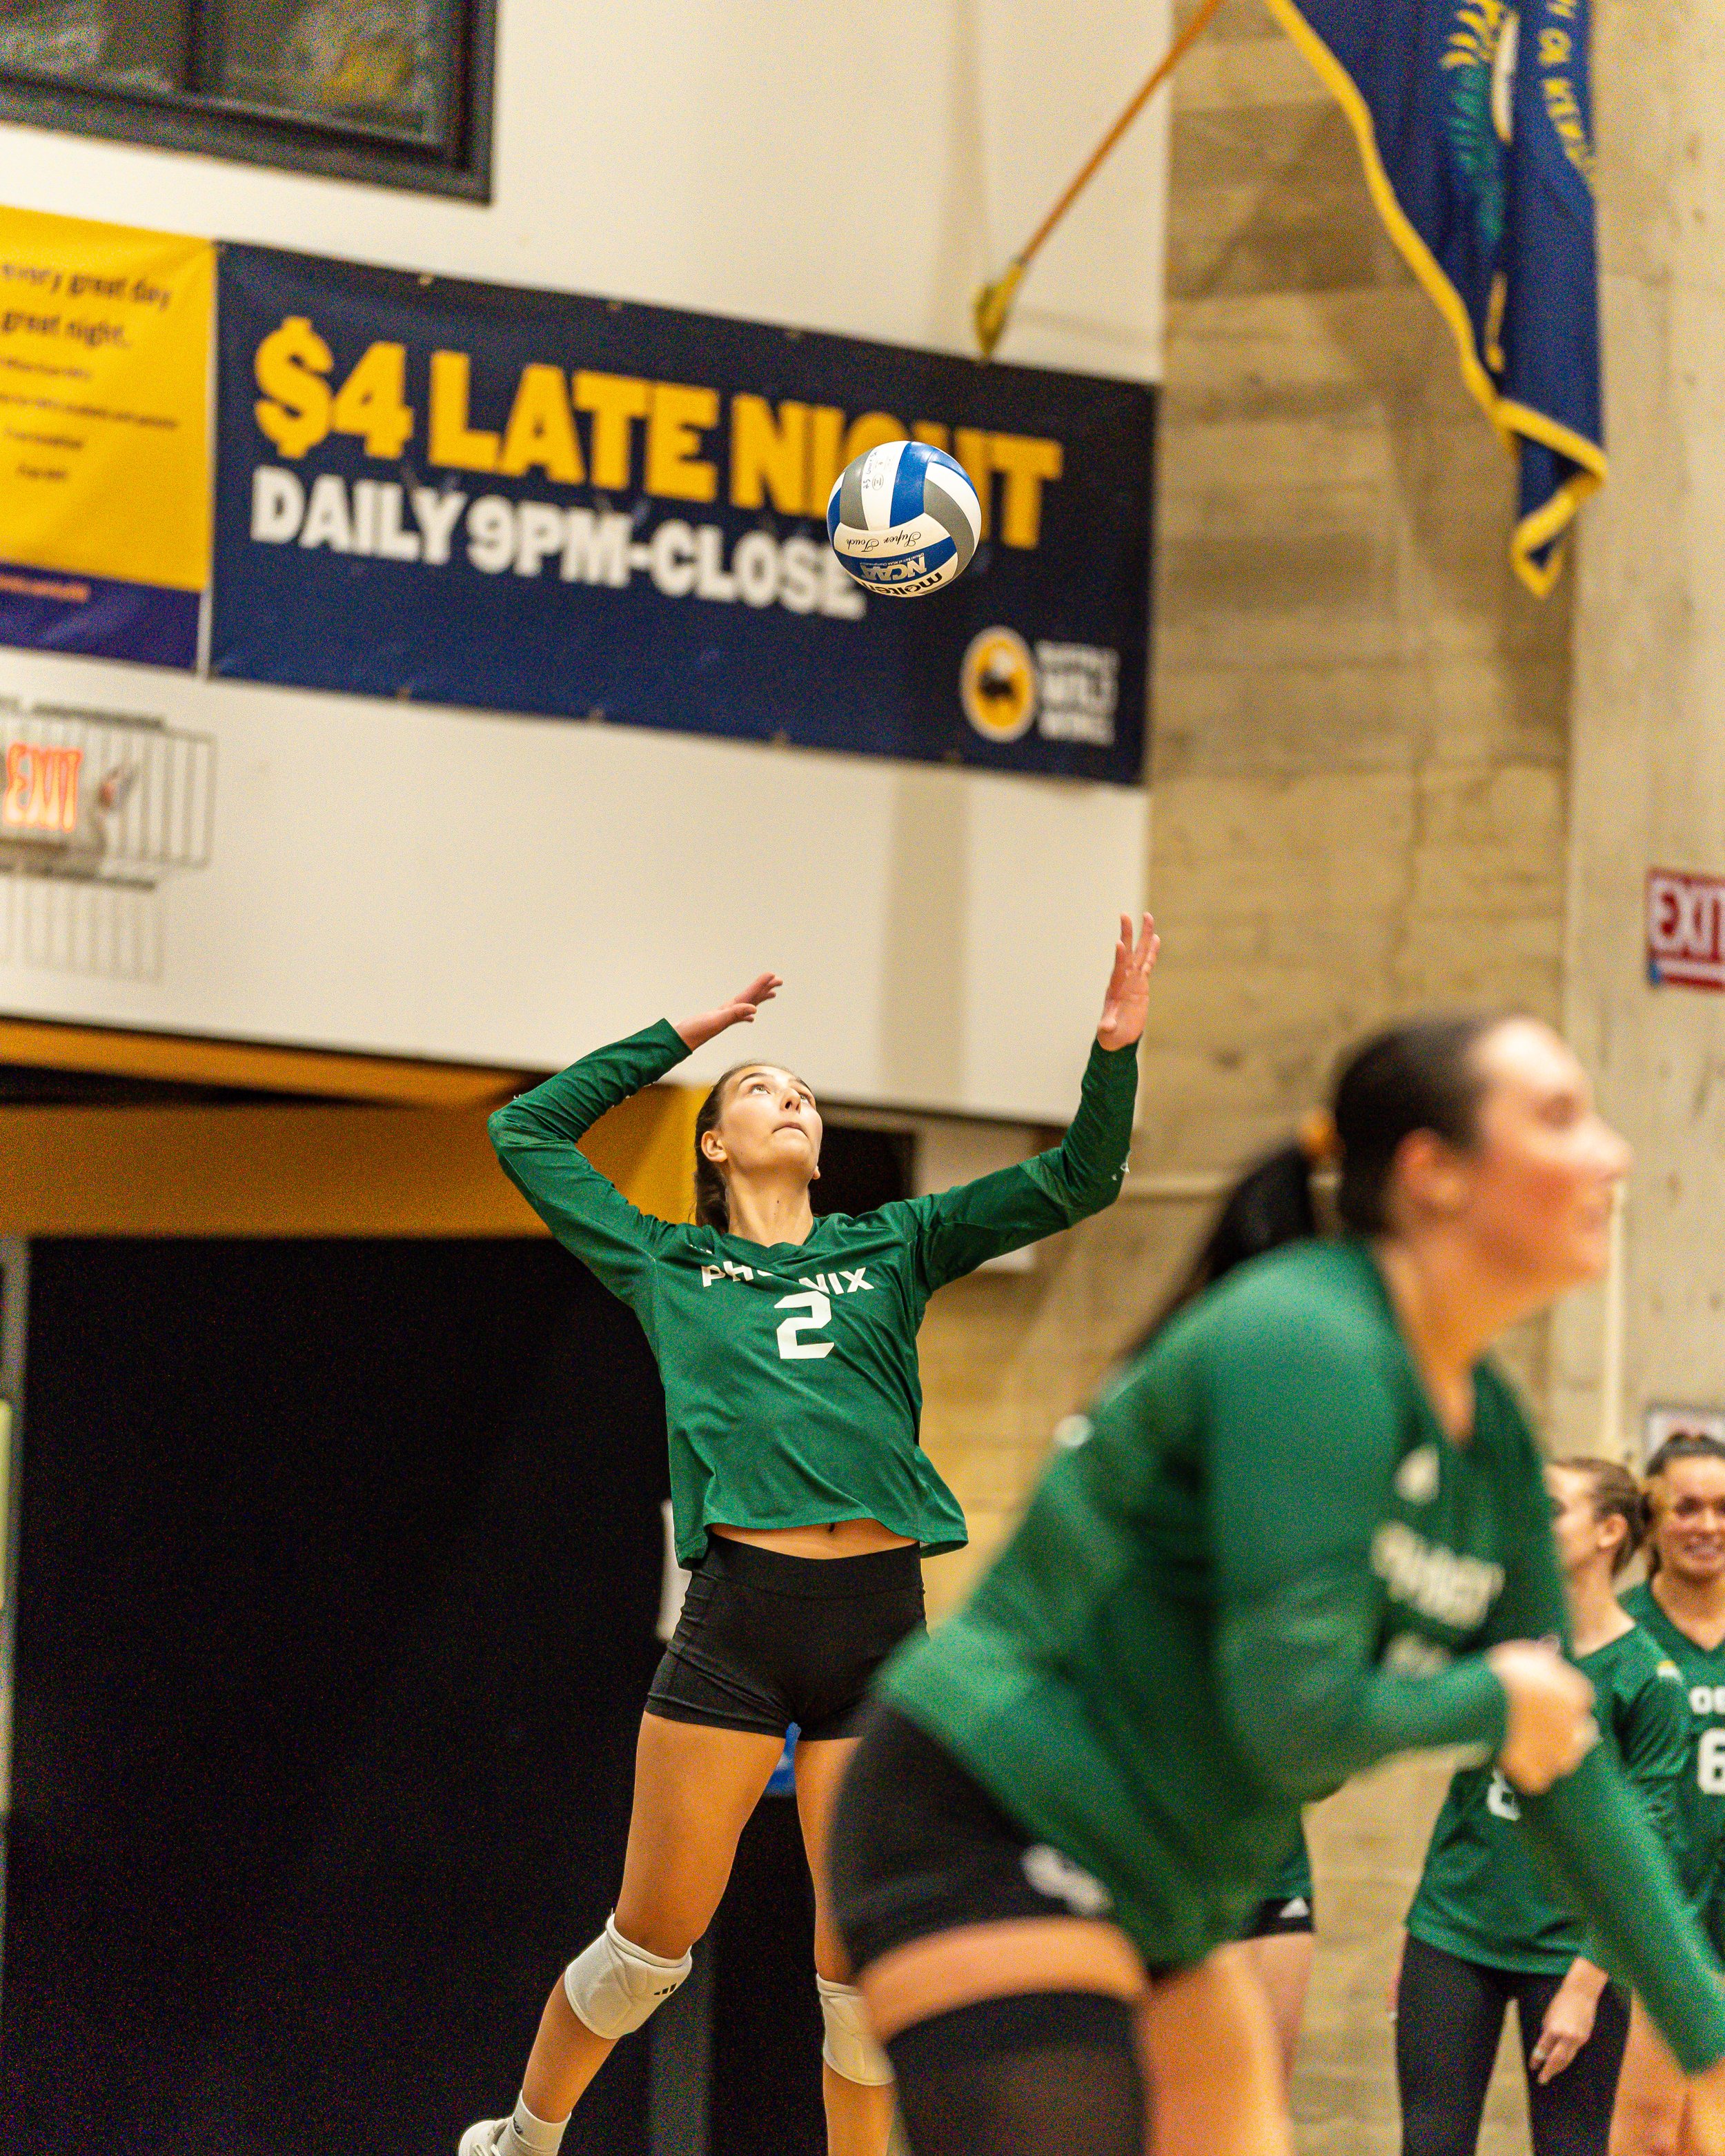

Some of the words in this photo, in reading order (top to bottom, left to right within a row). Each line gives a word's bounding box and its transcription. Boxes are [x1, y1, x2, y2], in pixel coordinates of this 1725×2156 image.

[253, 315, 413, 459] $4
[428, 349, 720, 503] LATE
[730, 391, 1063, 549] NIT
[250, 464, 468, 566] DAILY
[846, 538, 880, 553] Touch
[884, 530, 922, 547] Super
[860, 555, 927, 581] NCAA
[861, 572, 943, 597] molten
[701, 1260, 874, 1295] PHNIX
[773, 1290, 834, 1359] 2
